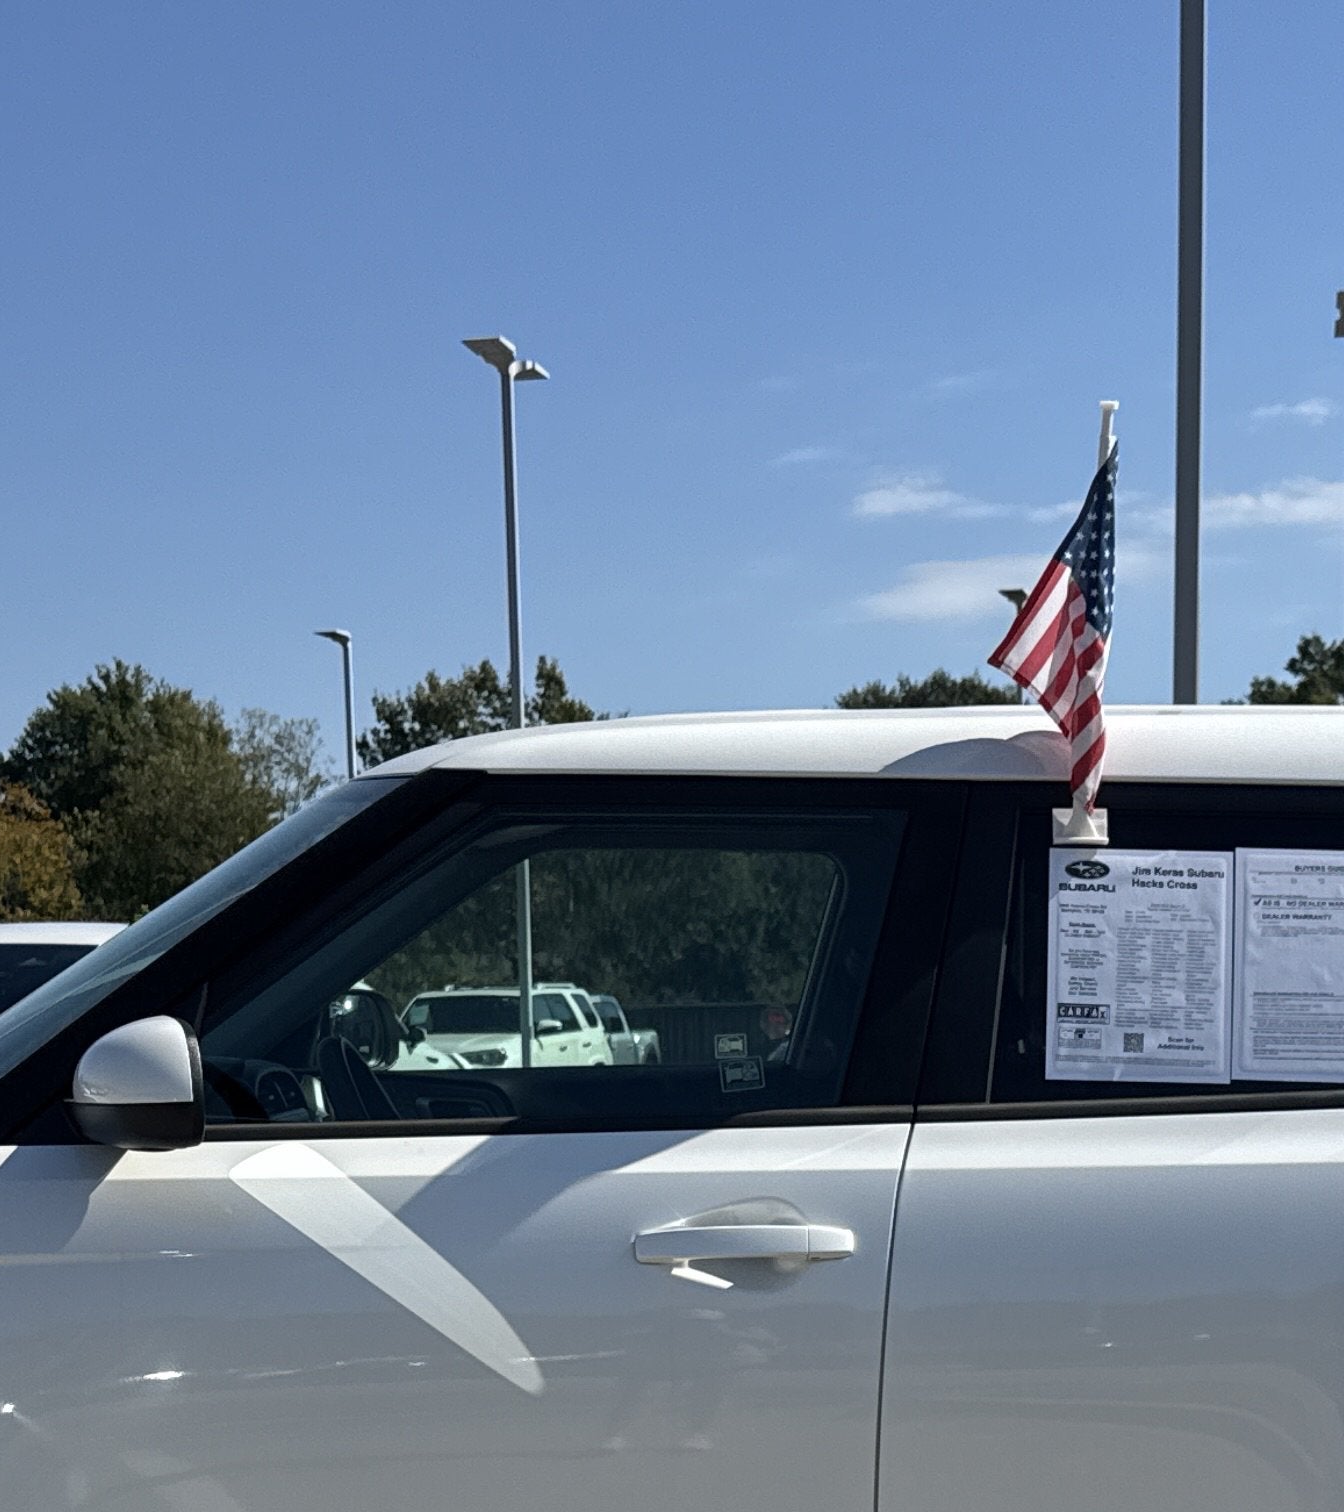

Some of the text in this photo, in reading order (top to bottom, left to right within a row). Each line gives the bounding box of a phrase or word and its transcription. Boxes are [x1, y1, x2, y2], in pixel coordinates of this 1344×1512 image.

[1187, 868, 1225, 879] Subaru
[1058, 882, 1116, 894] SUBARU
[1167, 880, 1198, 890] Cross
[1059, 1006, 1107, 1018] CARFAX
